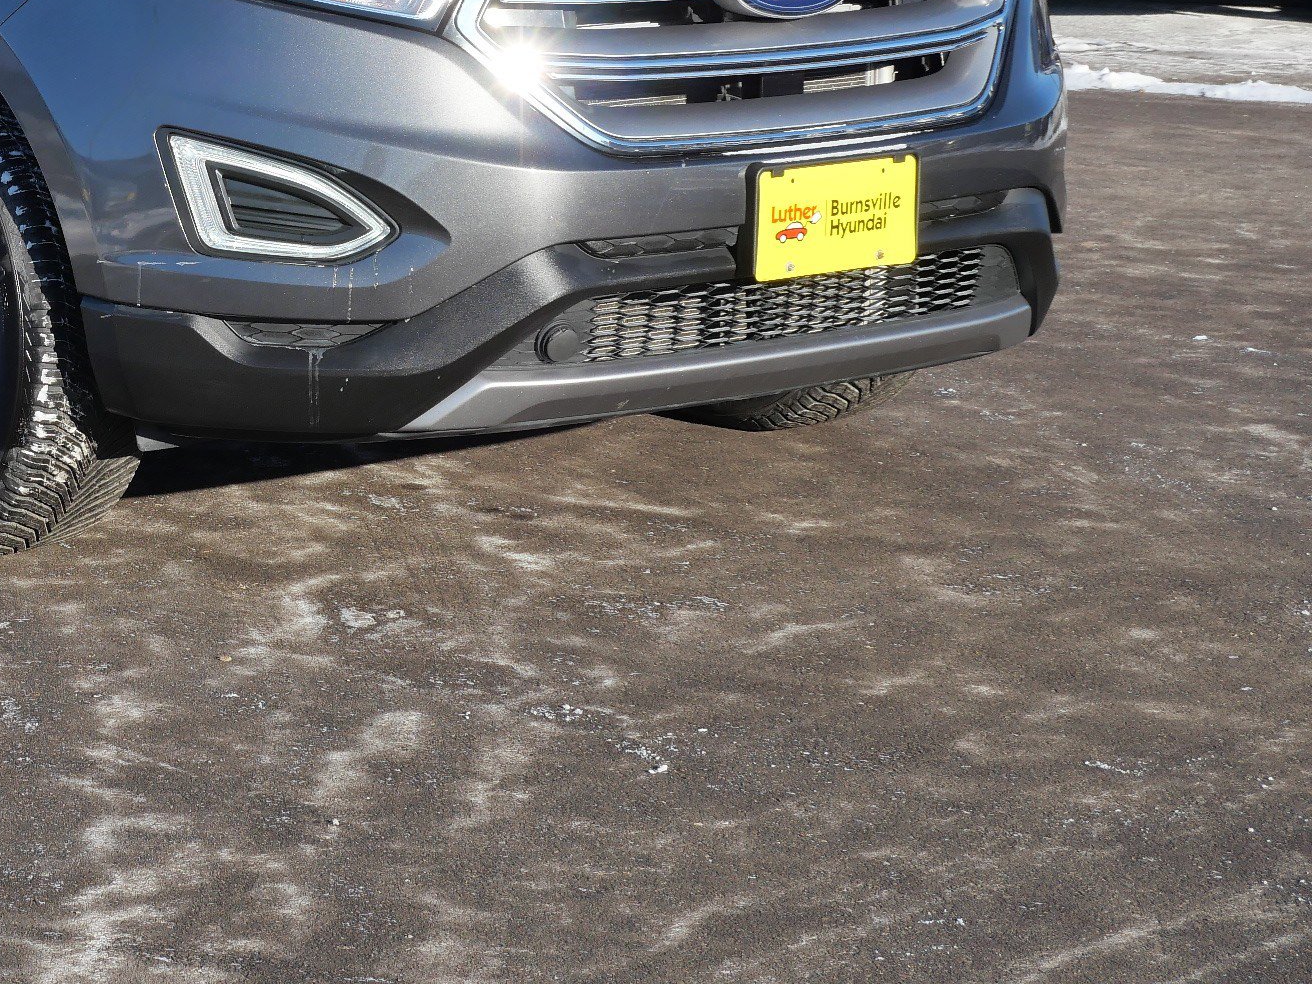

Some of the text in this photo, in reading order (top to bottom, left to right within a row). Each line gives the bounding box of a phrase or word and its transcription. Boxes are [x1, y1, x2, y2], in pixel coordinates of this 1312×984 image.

[771, 203, 818, 224] Luther
[830, 192, 901, 217] Burnsville
[829, 212, 887, 238] Hyundai
